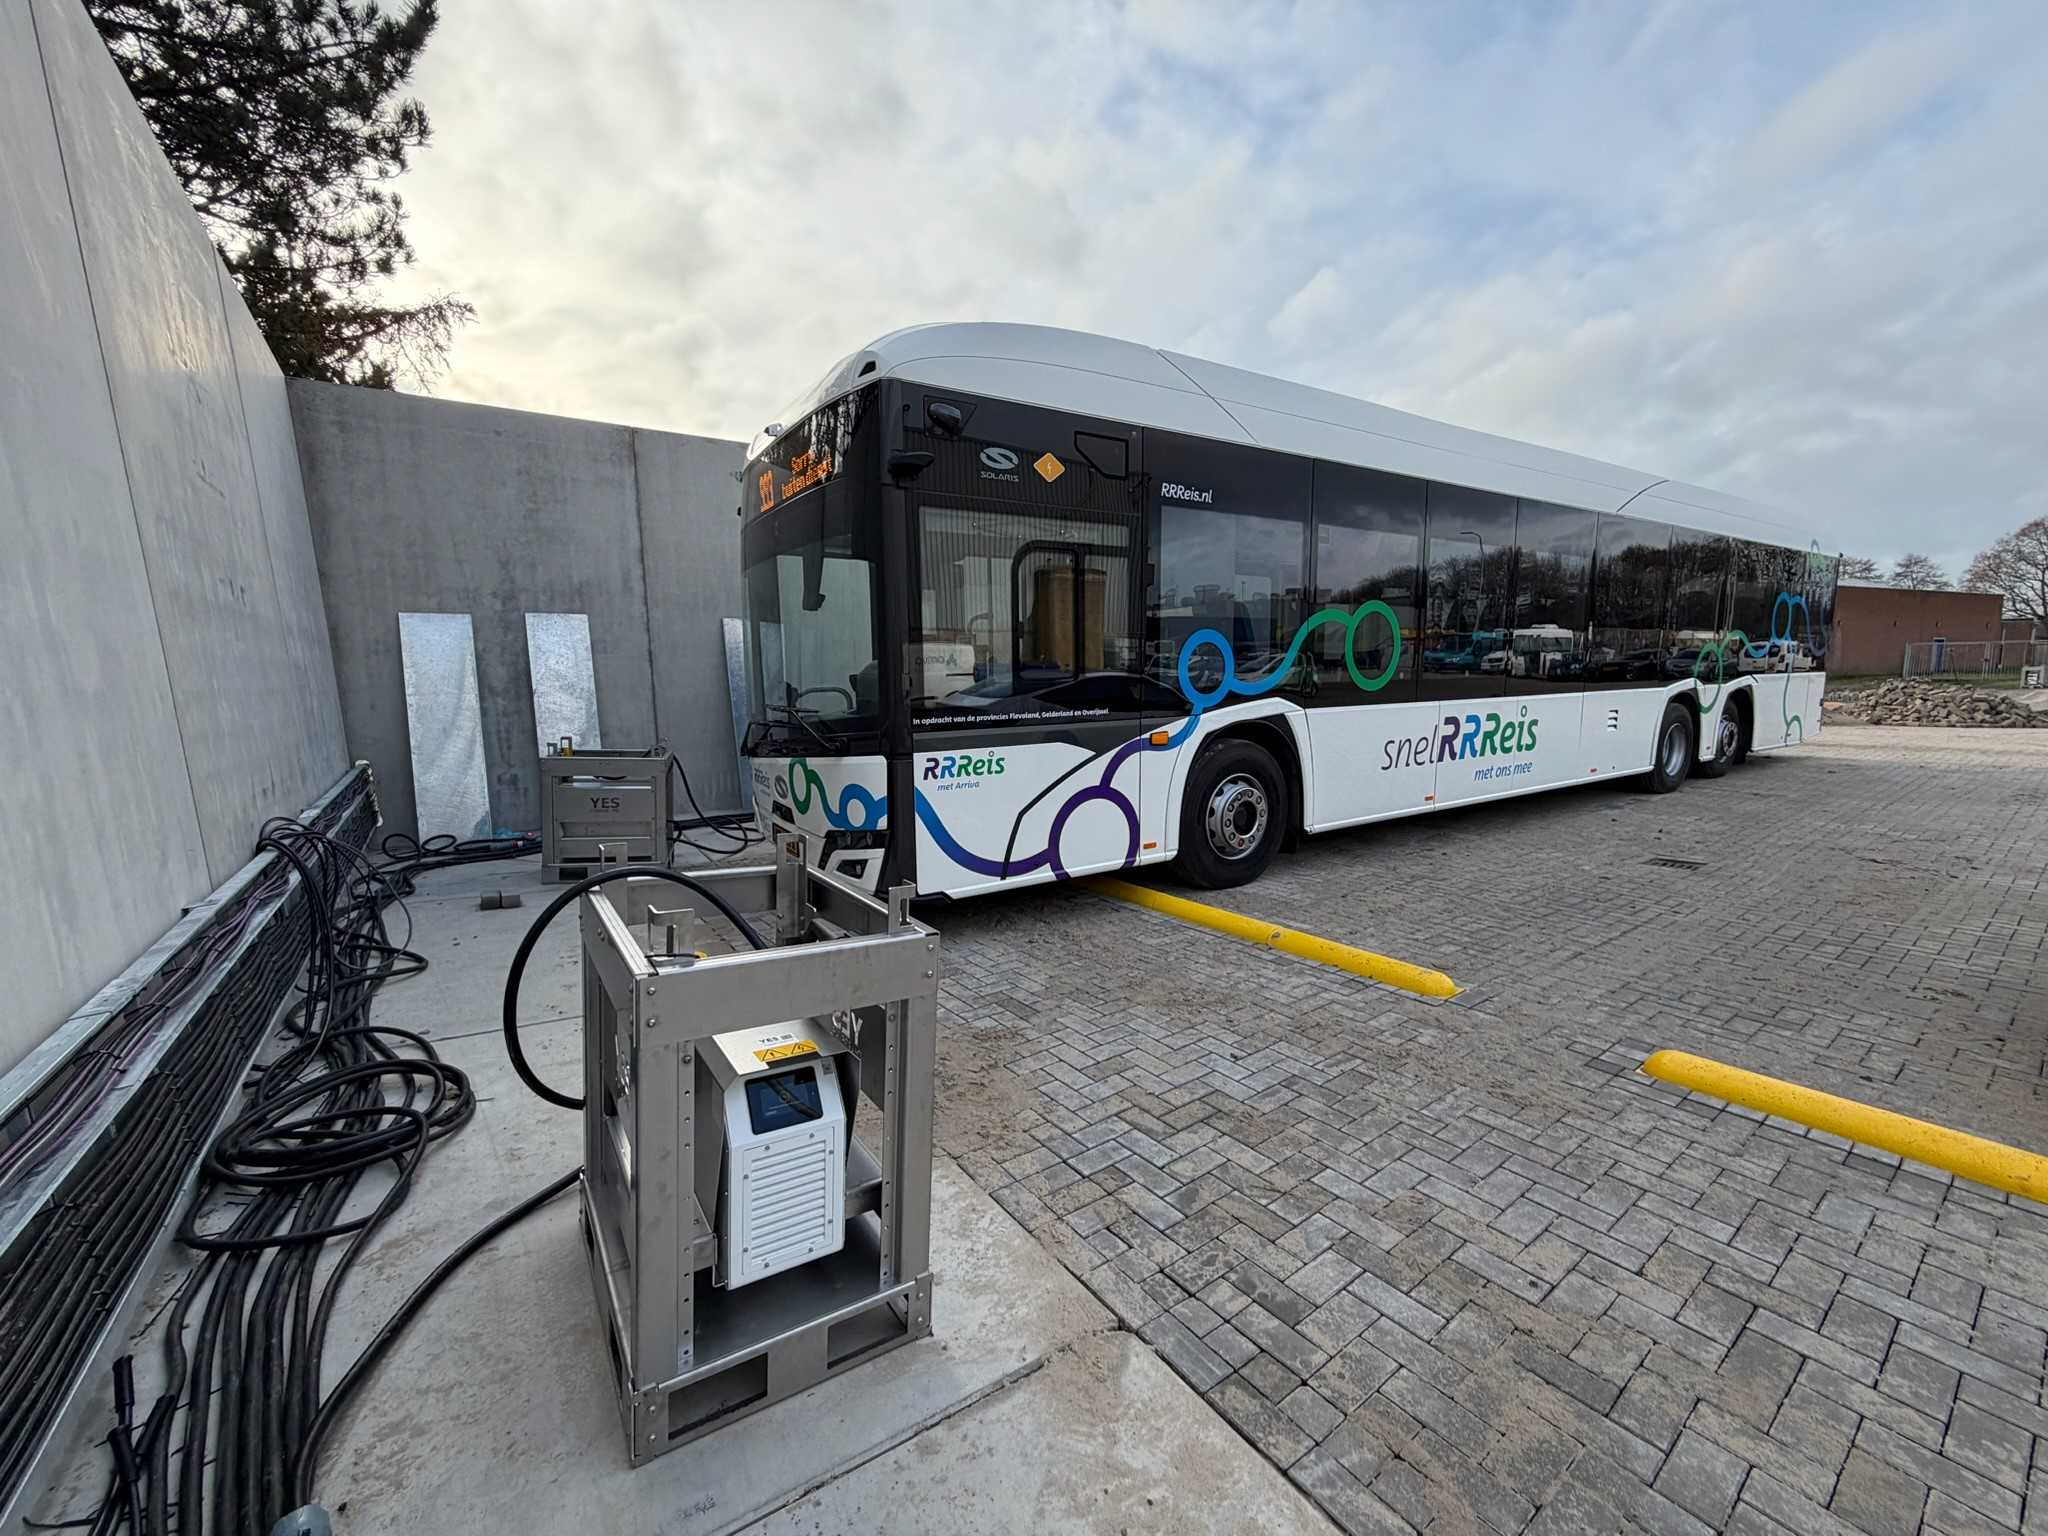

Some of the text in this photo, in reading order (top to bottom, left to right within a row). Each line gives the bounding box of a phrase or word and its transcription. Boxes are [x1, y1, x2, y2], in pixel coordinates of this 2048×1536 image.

[980, 471, 1020, 482] SOLARIS
[1160, 483, 1213, 503] RRReis.nl
[921, 716, 952, 726] opdracht
[976, 713, 1009, 722] provincies
[1041, 710, 1074, 718] Gelderland
[1381, 705, 1539, 771] snelRRReis
[923, 751, 1006, 781] RRReis
[1474, 761, 1533, 781] met ons mee
[937, 780, 980, 791] met Arriva
[590, 797, 620, 808] YES
